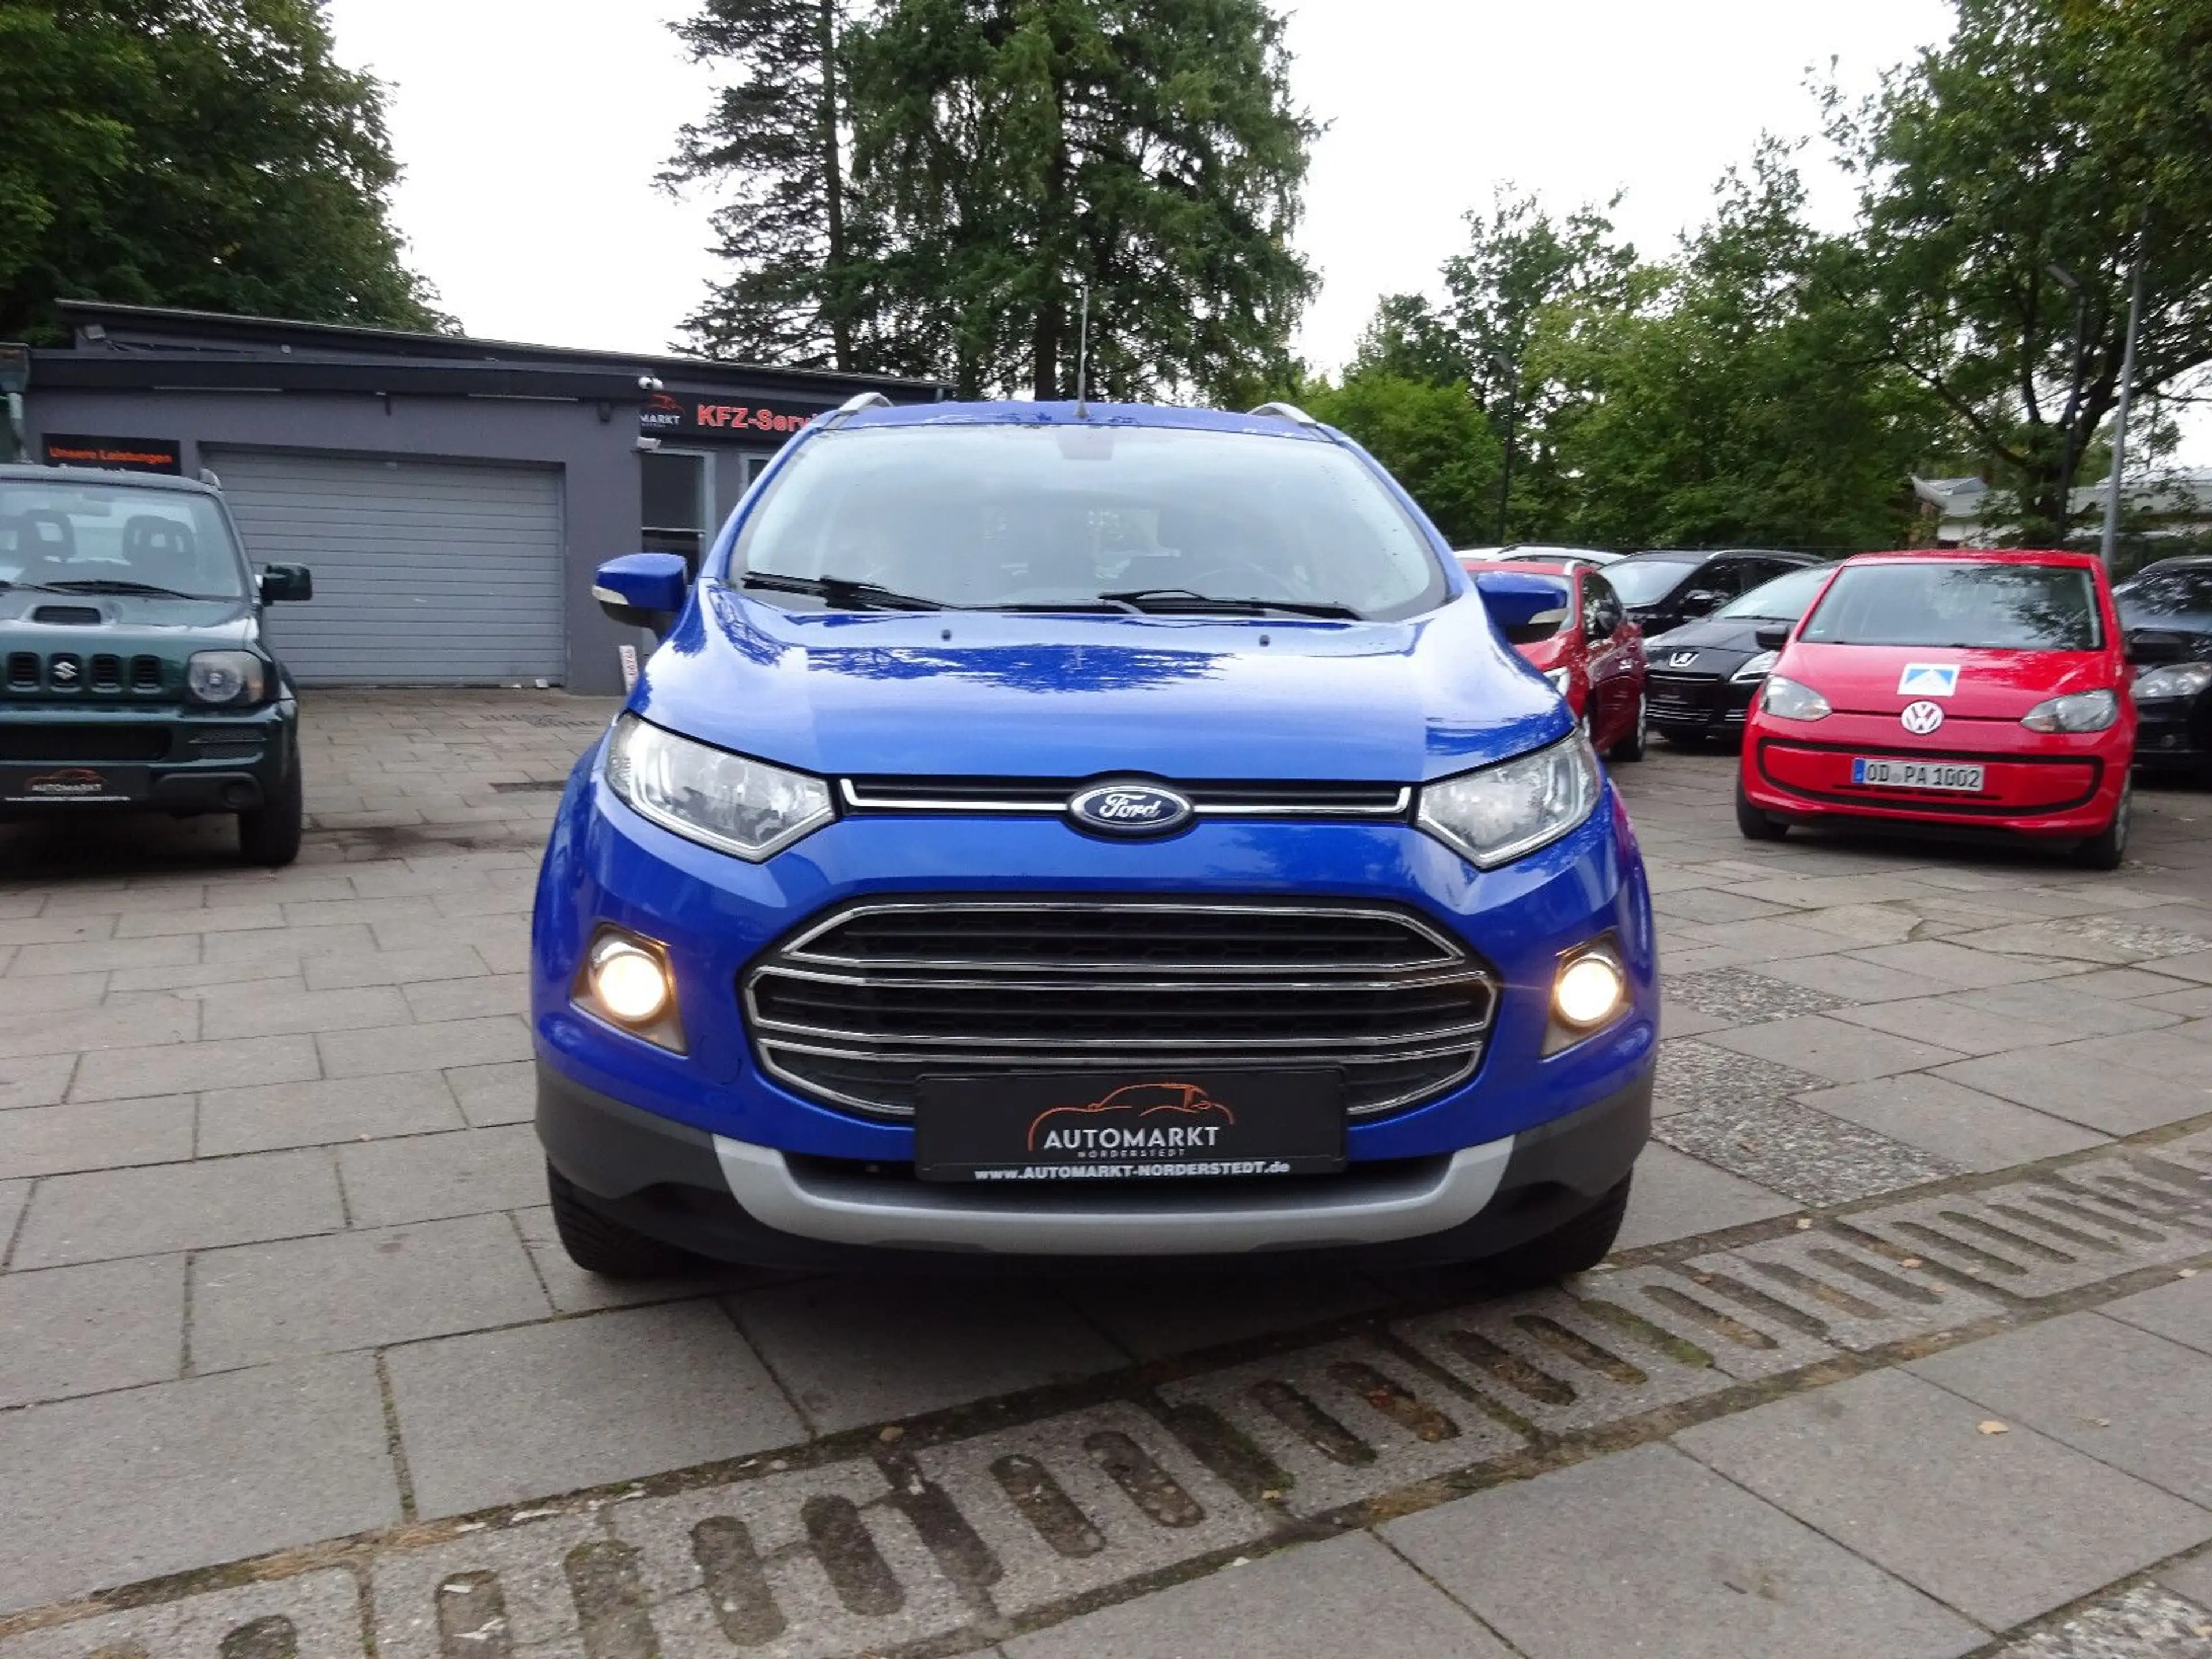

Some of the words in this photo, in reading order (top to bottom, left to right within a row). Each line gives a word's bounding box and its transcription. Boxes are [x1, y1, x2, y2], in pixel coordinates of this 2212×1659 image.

[696, 404, 818, 431] KFZ-Serv
[1868, 764, 1889, 782] OD
[1904, 765, 1927, 785] PA
[1933, 768, 1980, 788] 1002
[1099, 793, 1162, 818] Ford
[1043, 1126, 1220, 1149] AUTOMARKT
[1077, 1148, 1185, 1158] NORDERSTEDT
[974, 1161, 1291, 1179] www.AUTOMARKT-NORDERSTEDT.de
